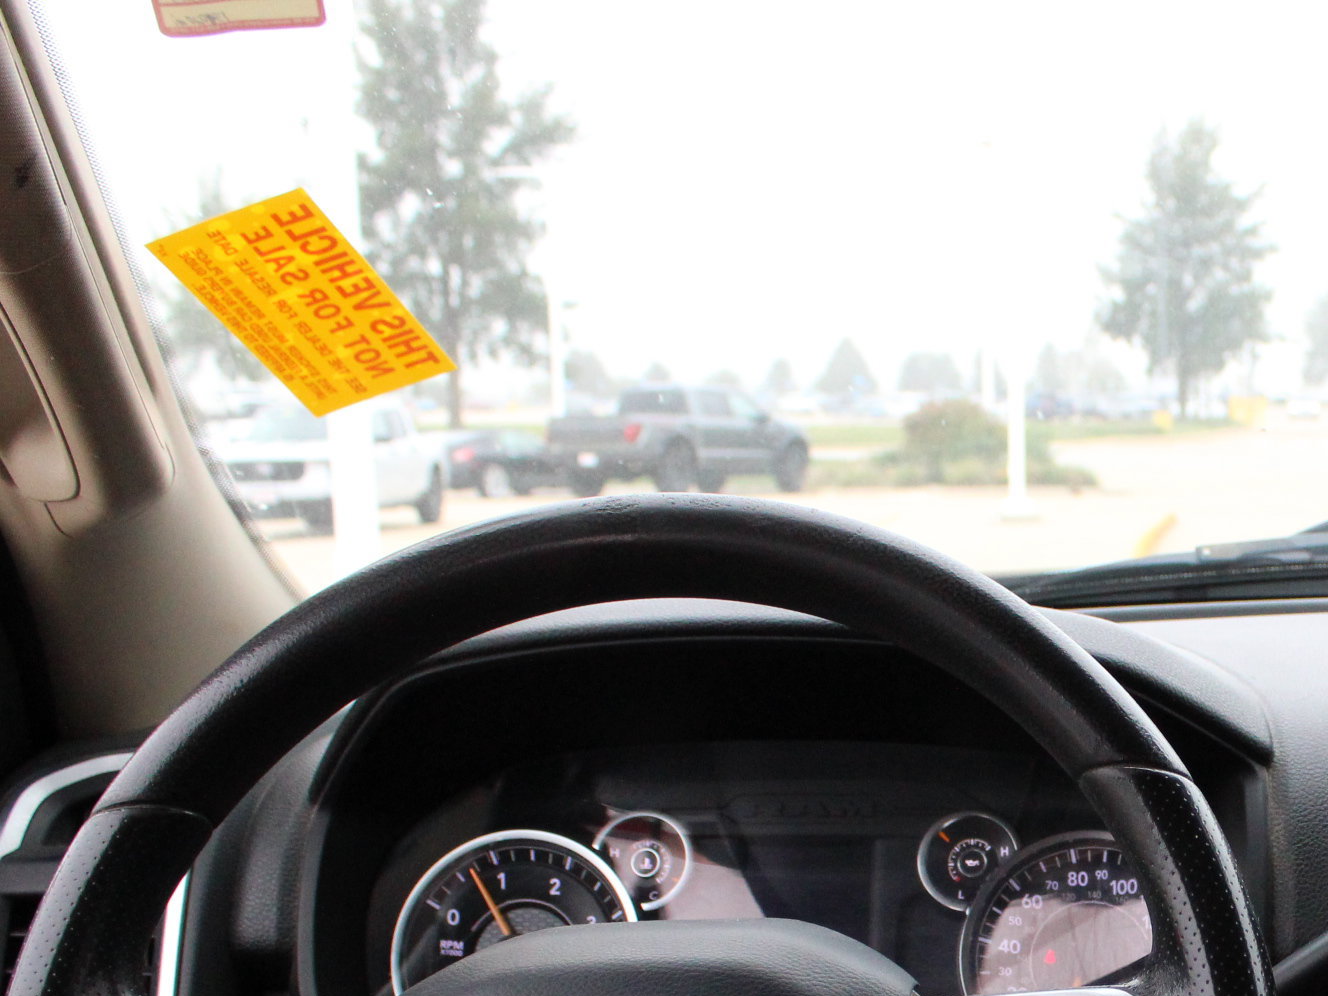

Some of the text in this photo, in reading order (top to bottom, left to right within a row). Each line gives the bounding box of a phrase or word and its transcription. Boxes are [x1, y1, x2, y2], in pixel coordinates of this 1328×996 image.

[1000, 846, 1009, 857] H
[497, 872, 506, 890] 1
[1067, 872, 1088, 887] 80
[1095, 870, 1108, 881] 90
[549, 878, 561, 896] 2
[1046, 880, 1059, 891] 70
[1109, 879, 1138, 895] 100
[958, 890, 965, 900] L
[1022, 894, 1043, 909] 60
[447, 909, 460, 926] 0
[1008, 916, 1022, 926] 50
[440, 939, 464, 950] RPM
[998, 940, 1021, 954] 40
[998, 967, 1012, 976] 30
